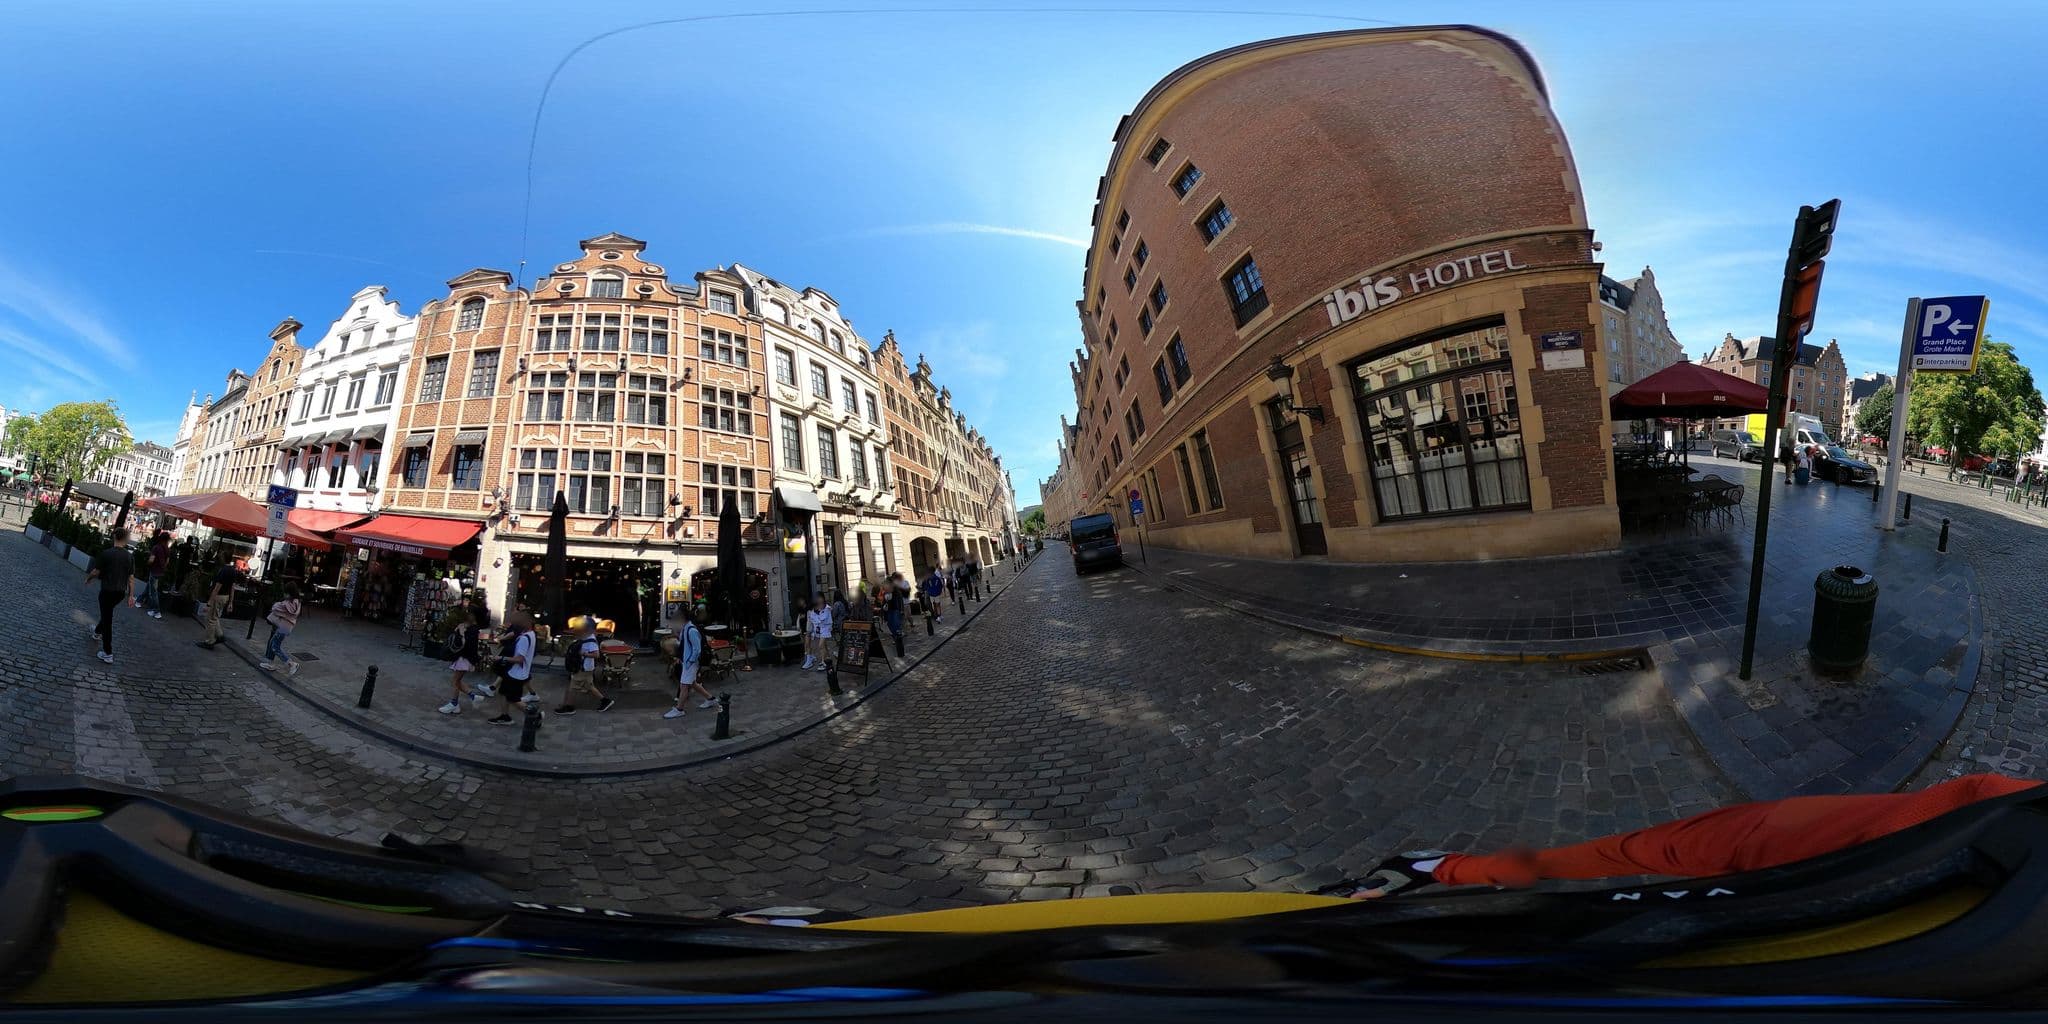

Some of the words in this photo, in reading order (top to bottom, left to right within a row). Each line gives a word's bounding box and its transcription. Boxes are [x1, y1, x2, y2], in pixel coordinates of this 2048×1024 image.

[1323, 276, 1402, 327] ibis
[1409, 249, 1528, 294] HOTEL
[1922, 304, 1952, 337] P
[1945, 338, 1967, 346] Place
[1943, 345, 1965, 353] Markt
[1924, 358, 1967, 367] interparking
